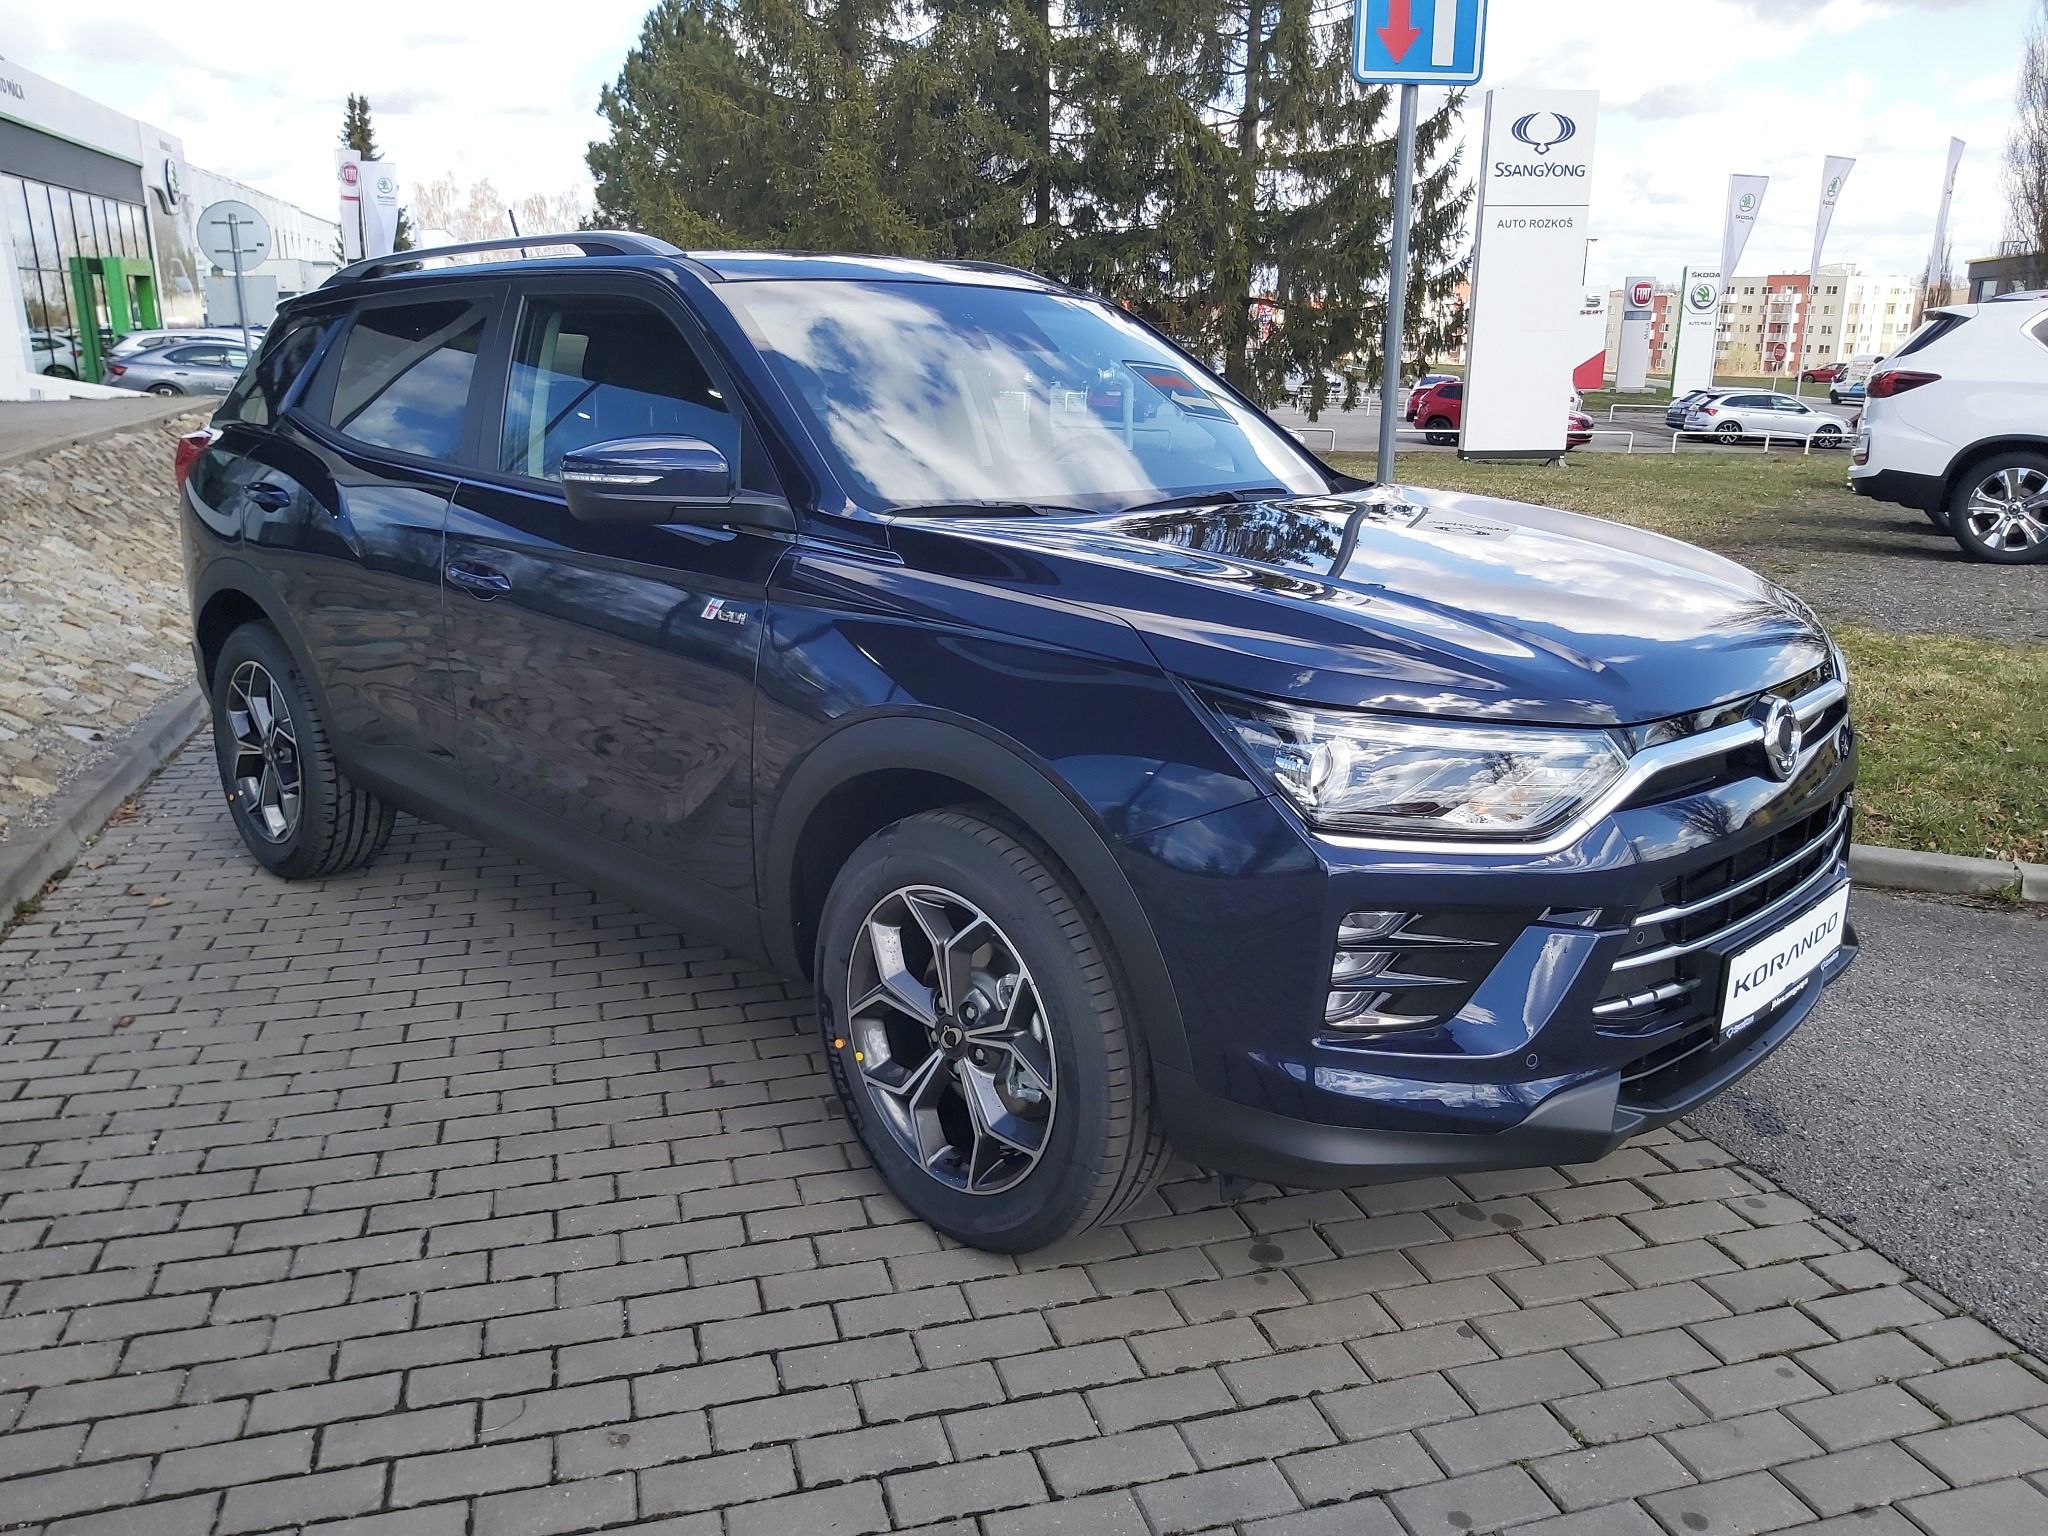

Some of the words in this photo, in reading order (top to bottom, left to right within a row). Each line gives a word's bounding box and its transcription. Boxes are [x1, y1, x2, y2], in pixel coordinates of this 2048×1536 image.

[1497, 219, 1527, 228] AUTO
[1529, 217, 1574, 228] ROZKOŠ
[1636, 288, 1652, 301] FIAT
[1733, 911, 1838, 999] KORANDO
